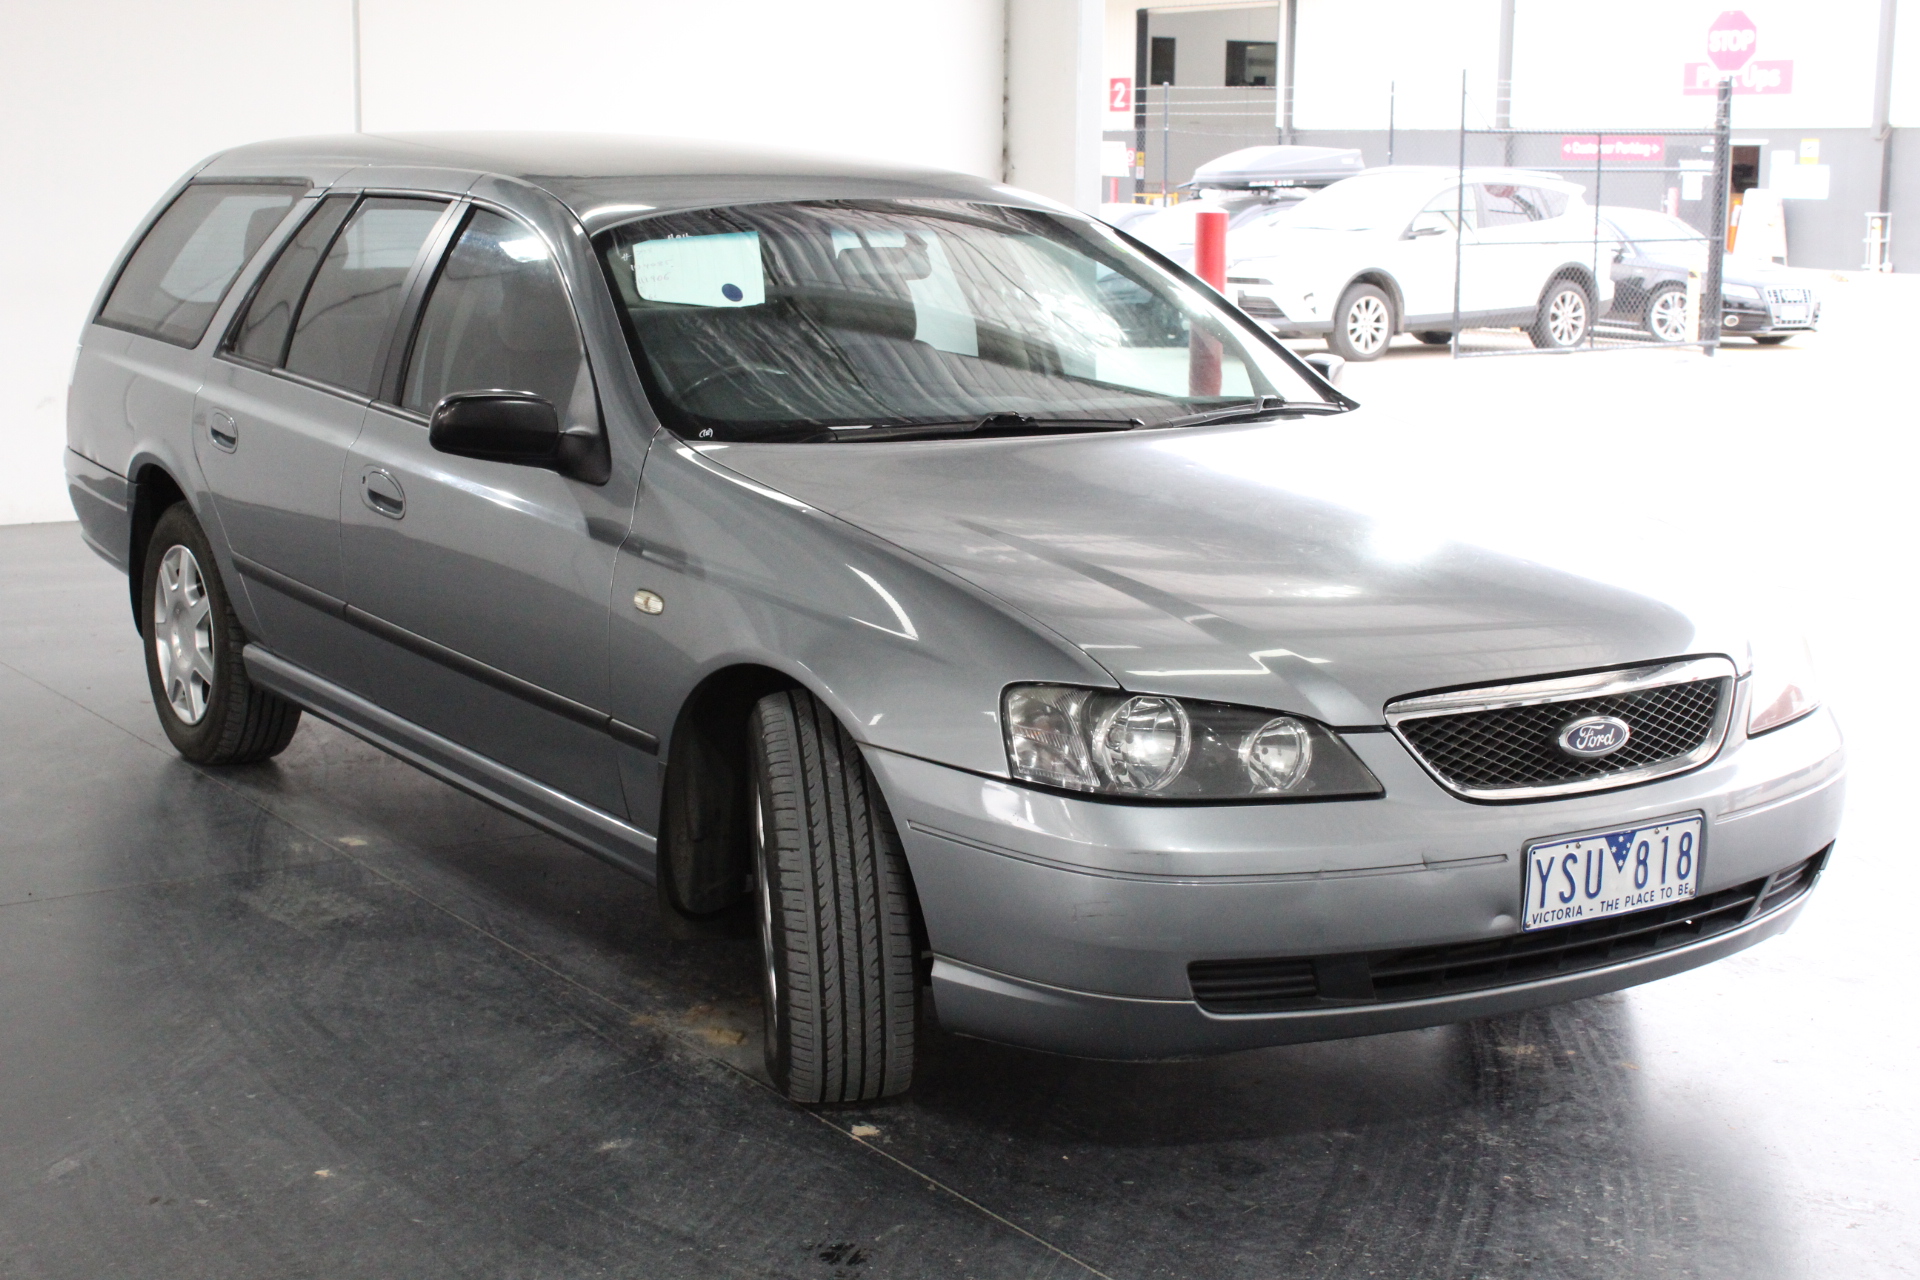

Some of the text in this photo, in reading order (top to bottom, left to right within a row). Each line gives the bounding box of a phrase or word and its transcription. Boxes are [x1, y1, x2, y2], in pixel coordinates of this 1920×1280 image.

[1709, 29, 1755, 52] STOP
[1742, 64, 1780, 92] Ups
[1113, 82, 1126, 108] 2
[1576, 724, 1615, 749] Ford
[1536, 831, 1693, 909] YSU 818
[1532, 905, 1583, 925] VICTORIA
[1600, 896, 1620, 912] THE
[1624, 892, 1655, 906] PLACE
[1660, 887, 1673, 900] TO
[1678, 882, 1690, 895] BE
